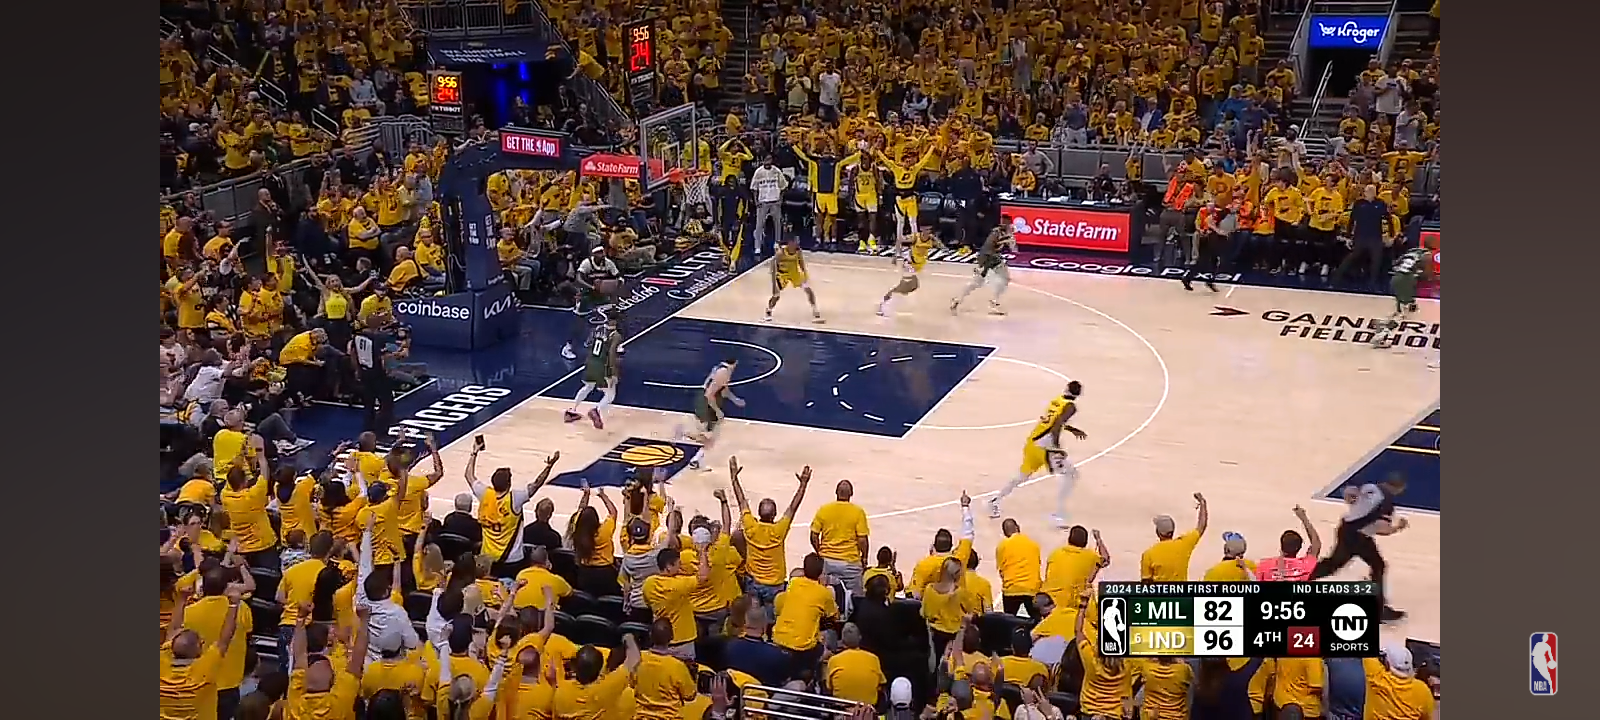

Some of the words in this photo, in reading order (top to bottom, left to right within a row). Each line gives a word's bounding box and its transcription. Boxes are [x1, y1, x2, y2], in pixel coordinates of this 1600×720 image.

[1337, 21, 1380, 43] Kroger
[631, 41, 650, 71] 24
[506, 136, 520, 149] GET
[521, 137, 535, 151] THE
[542, 139, 556, 155] App
[1030, 257, 1152, 275] Google
[1160, 267, 1241, 282] Pixel
[397, 300, 470, 319] coinbase
[592, 339, 603, 356] 0
[387, 384, 512, 439] PACERS
